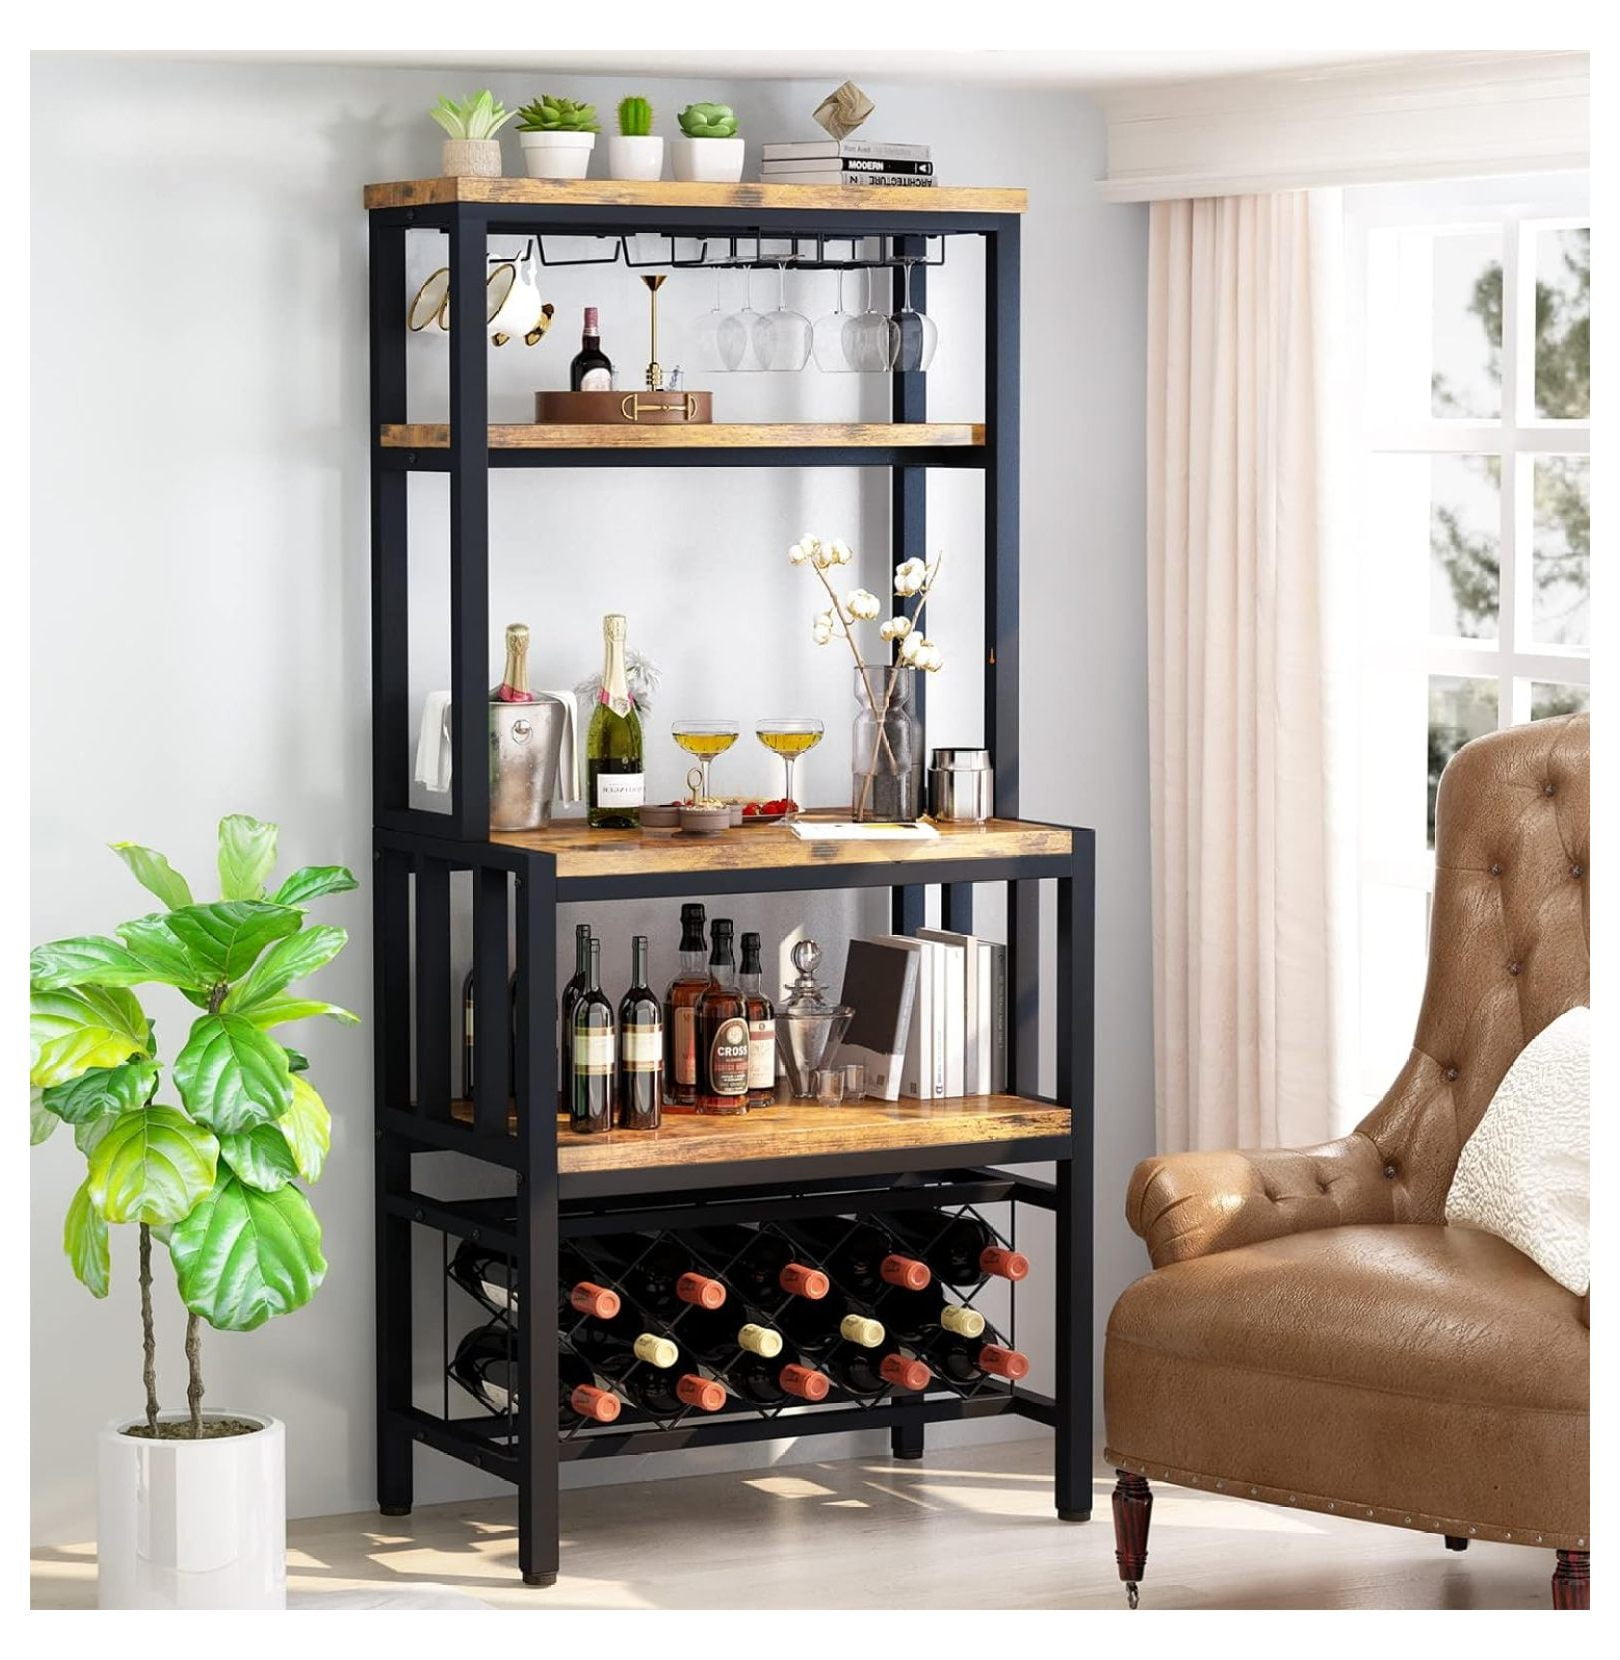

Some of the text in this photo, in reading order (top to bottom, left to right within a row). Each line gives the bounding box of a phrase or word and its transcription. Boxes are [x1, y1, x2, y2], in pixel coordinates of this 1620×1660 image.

[848, 160, 885, 171] MODERN
[869, 175, 933, 187] ARCHITECTURE
[717, 1045, 748, 1057] CROSS
